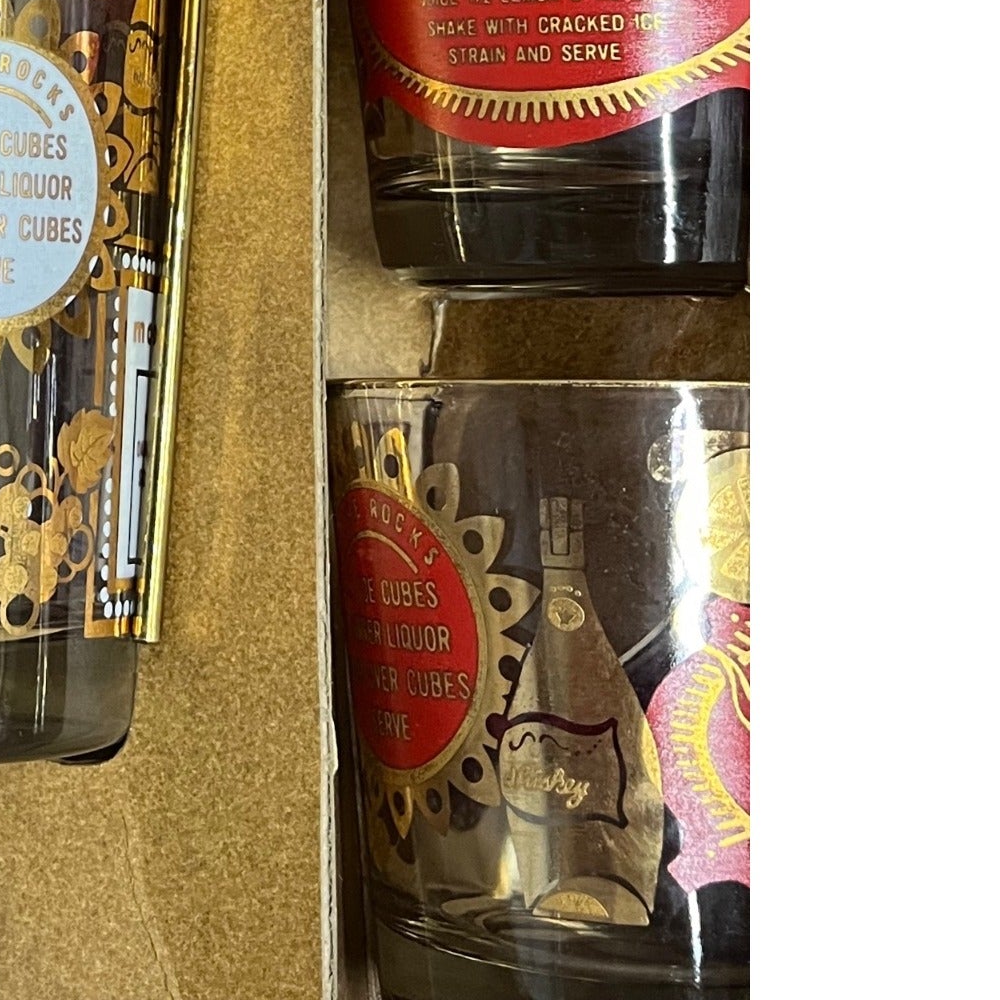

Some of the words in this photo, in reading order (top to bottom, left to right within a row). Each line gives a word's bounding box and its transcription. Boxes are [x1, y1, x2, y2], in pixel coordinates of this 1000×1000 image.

[427, 18, 477, 37] SHAKE
[485, 16, 528, 35] WITH
[538, 13, 625, 34] CRACKED
[449, 46, 506, 65] STRAIN
[516, 45, 551, 63] AND
[561, 43, 622, 62] SERVE
[0, 53, 75, 122] ROCKS
[0, 130, 68, 160] CUBES
[0, 171, 72, 201] LIQUOR
[18, 215, 83, 244] CUBES
[370, 500, 441, 567] ROCKS
[381, 580, 439, 609] CUBES
[387, 625, 450, 652] LIQUOR
[406, 669, 471, 700] CUBES
